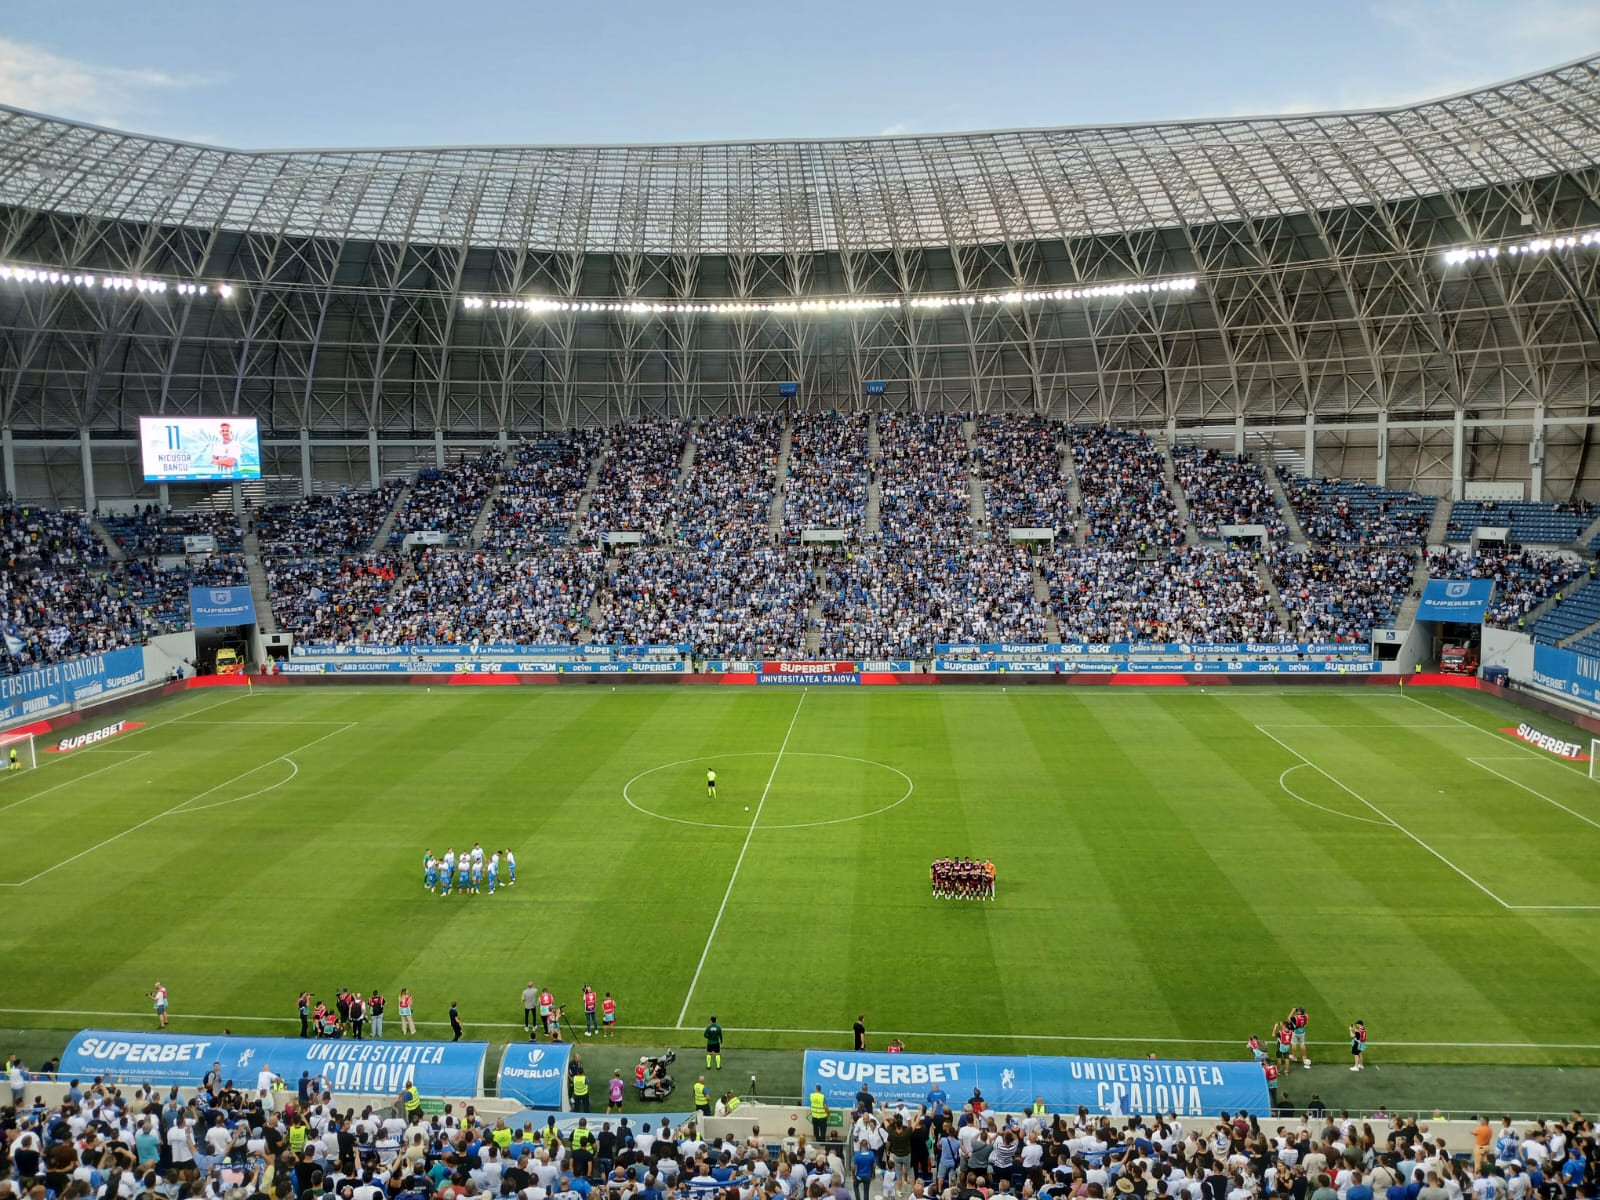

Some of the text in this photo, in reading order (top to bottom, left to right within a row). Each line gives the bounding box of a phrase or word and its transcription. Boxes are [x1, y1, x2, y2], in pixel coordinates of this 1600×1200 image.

[165, 425, 181, 450] 11
[163, 463, 189, 472] BANCU
[196, 605, 249, 614] SUPERBET
[355, 646, 402, 655] SUPERLIGA
[1001, 644, 1048, 653] SUPERBET
[1192, 645, 1240, 653] TeraSteel
[63, 656, 105, 682] CRAIOVA
[282, 663, 326, 672] SUPERBET
[358, 663, 390, 671] SECURITY
[632, 662, 678, 672] SUPERBET
[780, 662, 837, 673] SUPERBET
[943, 662, 991, 671] SUPERBET
[107, 669, 144, 688] SUPERBET
[760, 675, 857, 683] UNIVERSITATEA CRAIOVA
[1533, 670, 1567, 690] SUPERBET
[58, 720, 127, 751] SUPERBET
[1516, 723, 1582, 758] SUPERBET
[78, 1038, 211, 1062] SUPERBET
[306, 1043, 446, 1064] UNIVERSITATEA
[321, 1061, 416, 1093] CRAIOVA
[503, 1066, 560, 1078] SUPERLIGA
[818, 1059, 961, 1084] SUPERBET
[1070, 1061, 1225, 1086] UNIVERSITATEA
